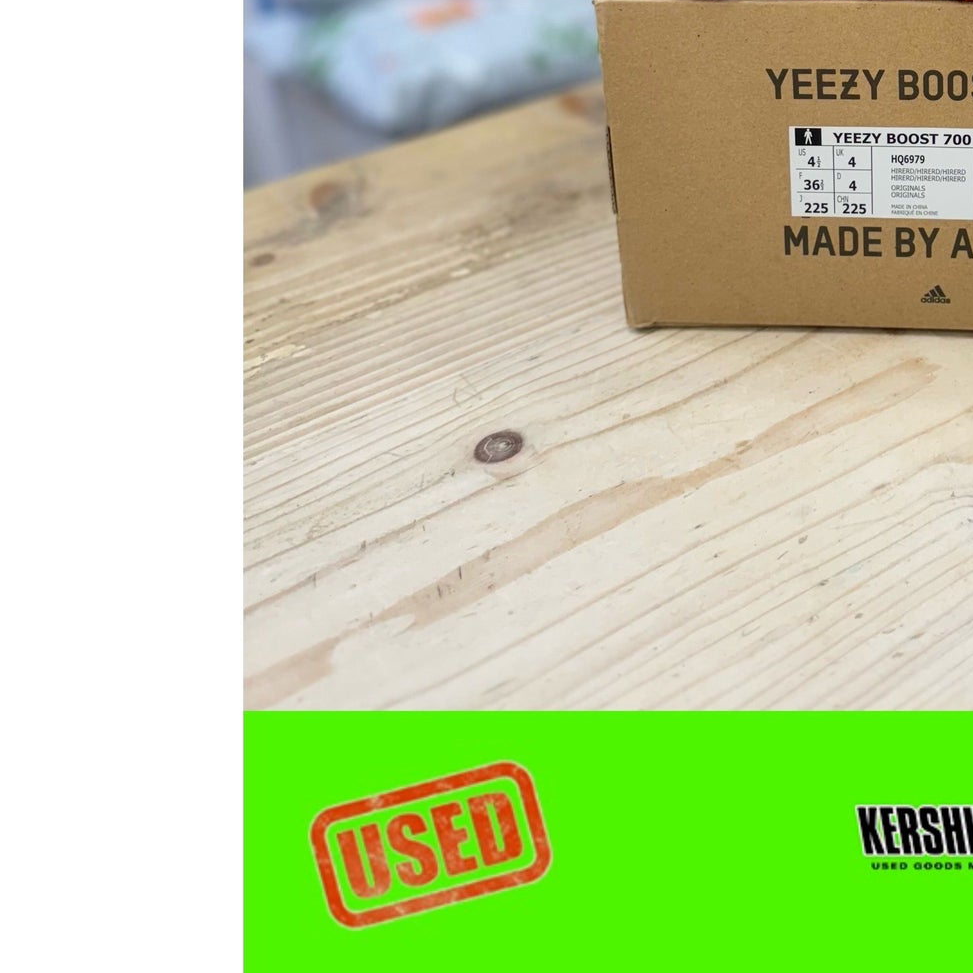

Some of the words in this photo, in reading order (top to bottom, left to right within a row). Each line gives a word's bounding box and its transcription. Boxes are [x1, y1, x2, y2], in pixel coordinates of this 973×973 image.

[765, 68, 885, 100] YEEZY
[833, 132, 882, 144] YEEZY
[887, 133, 939, 145] BOOST
[943, 134, 972, 146] 700
[798, 148, 806, 156] US
[848, 157, 856, 167] 4
[891, 154, 926, 164] HQ6979
[891, 168, 967, 176] HIRERD/HIRERD/HIRERD
[891, 175, 967, 183] HIRERD/HIRERD/HIRERD
[849, 180, 857, 191] 4
[891, 184, 926, 192] ORIGINALS
[891, 191, 926, 199] ORIGINALS
[804, 202, 828, 214] 225
[842, 203, 867, 214] 225
[783, 225, 882, 257] MADE
[895, 227, 939, 259] BY
[920, 295, 951, 304] adidas
